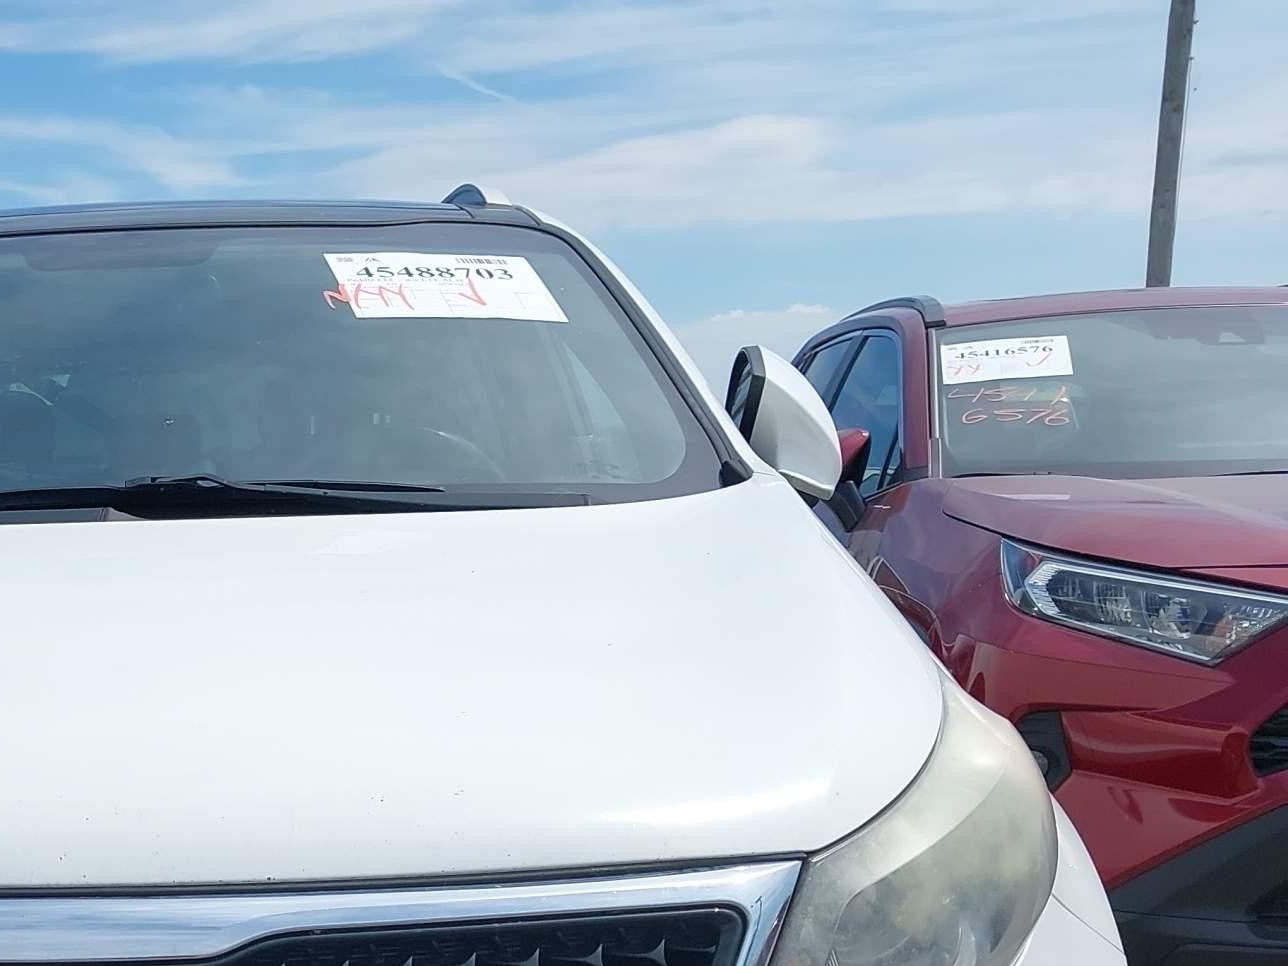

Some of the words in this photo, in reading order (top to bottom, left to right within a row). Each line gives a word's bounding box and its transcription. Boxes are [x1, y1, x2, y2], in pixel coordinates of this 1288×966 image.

[356, 266, 513, 281] 45488703
[955, 345, 1054, 360] 45416576
[962, 408, 1070, 426] 6576
